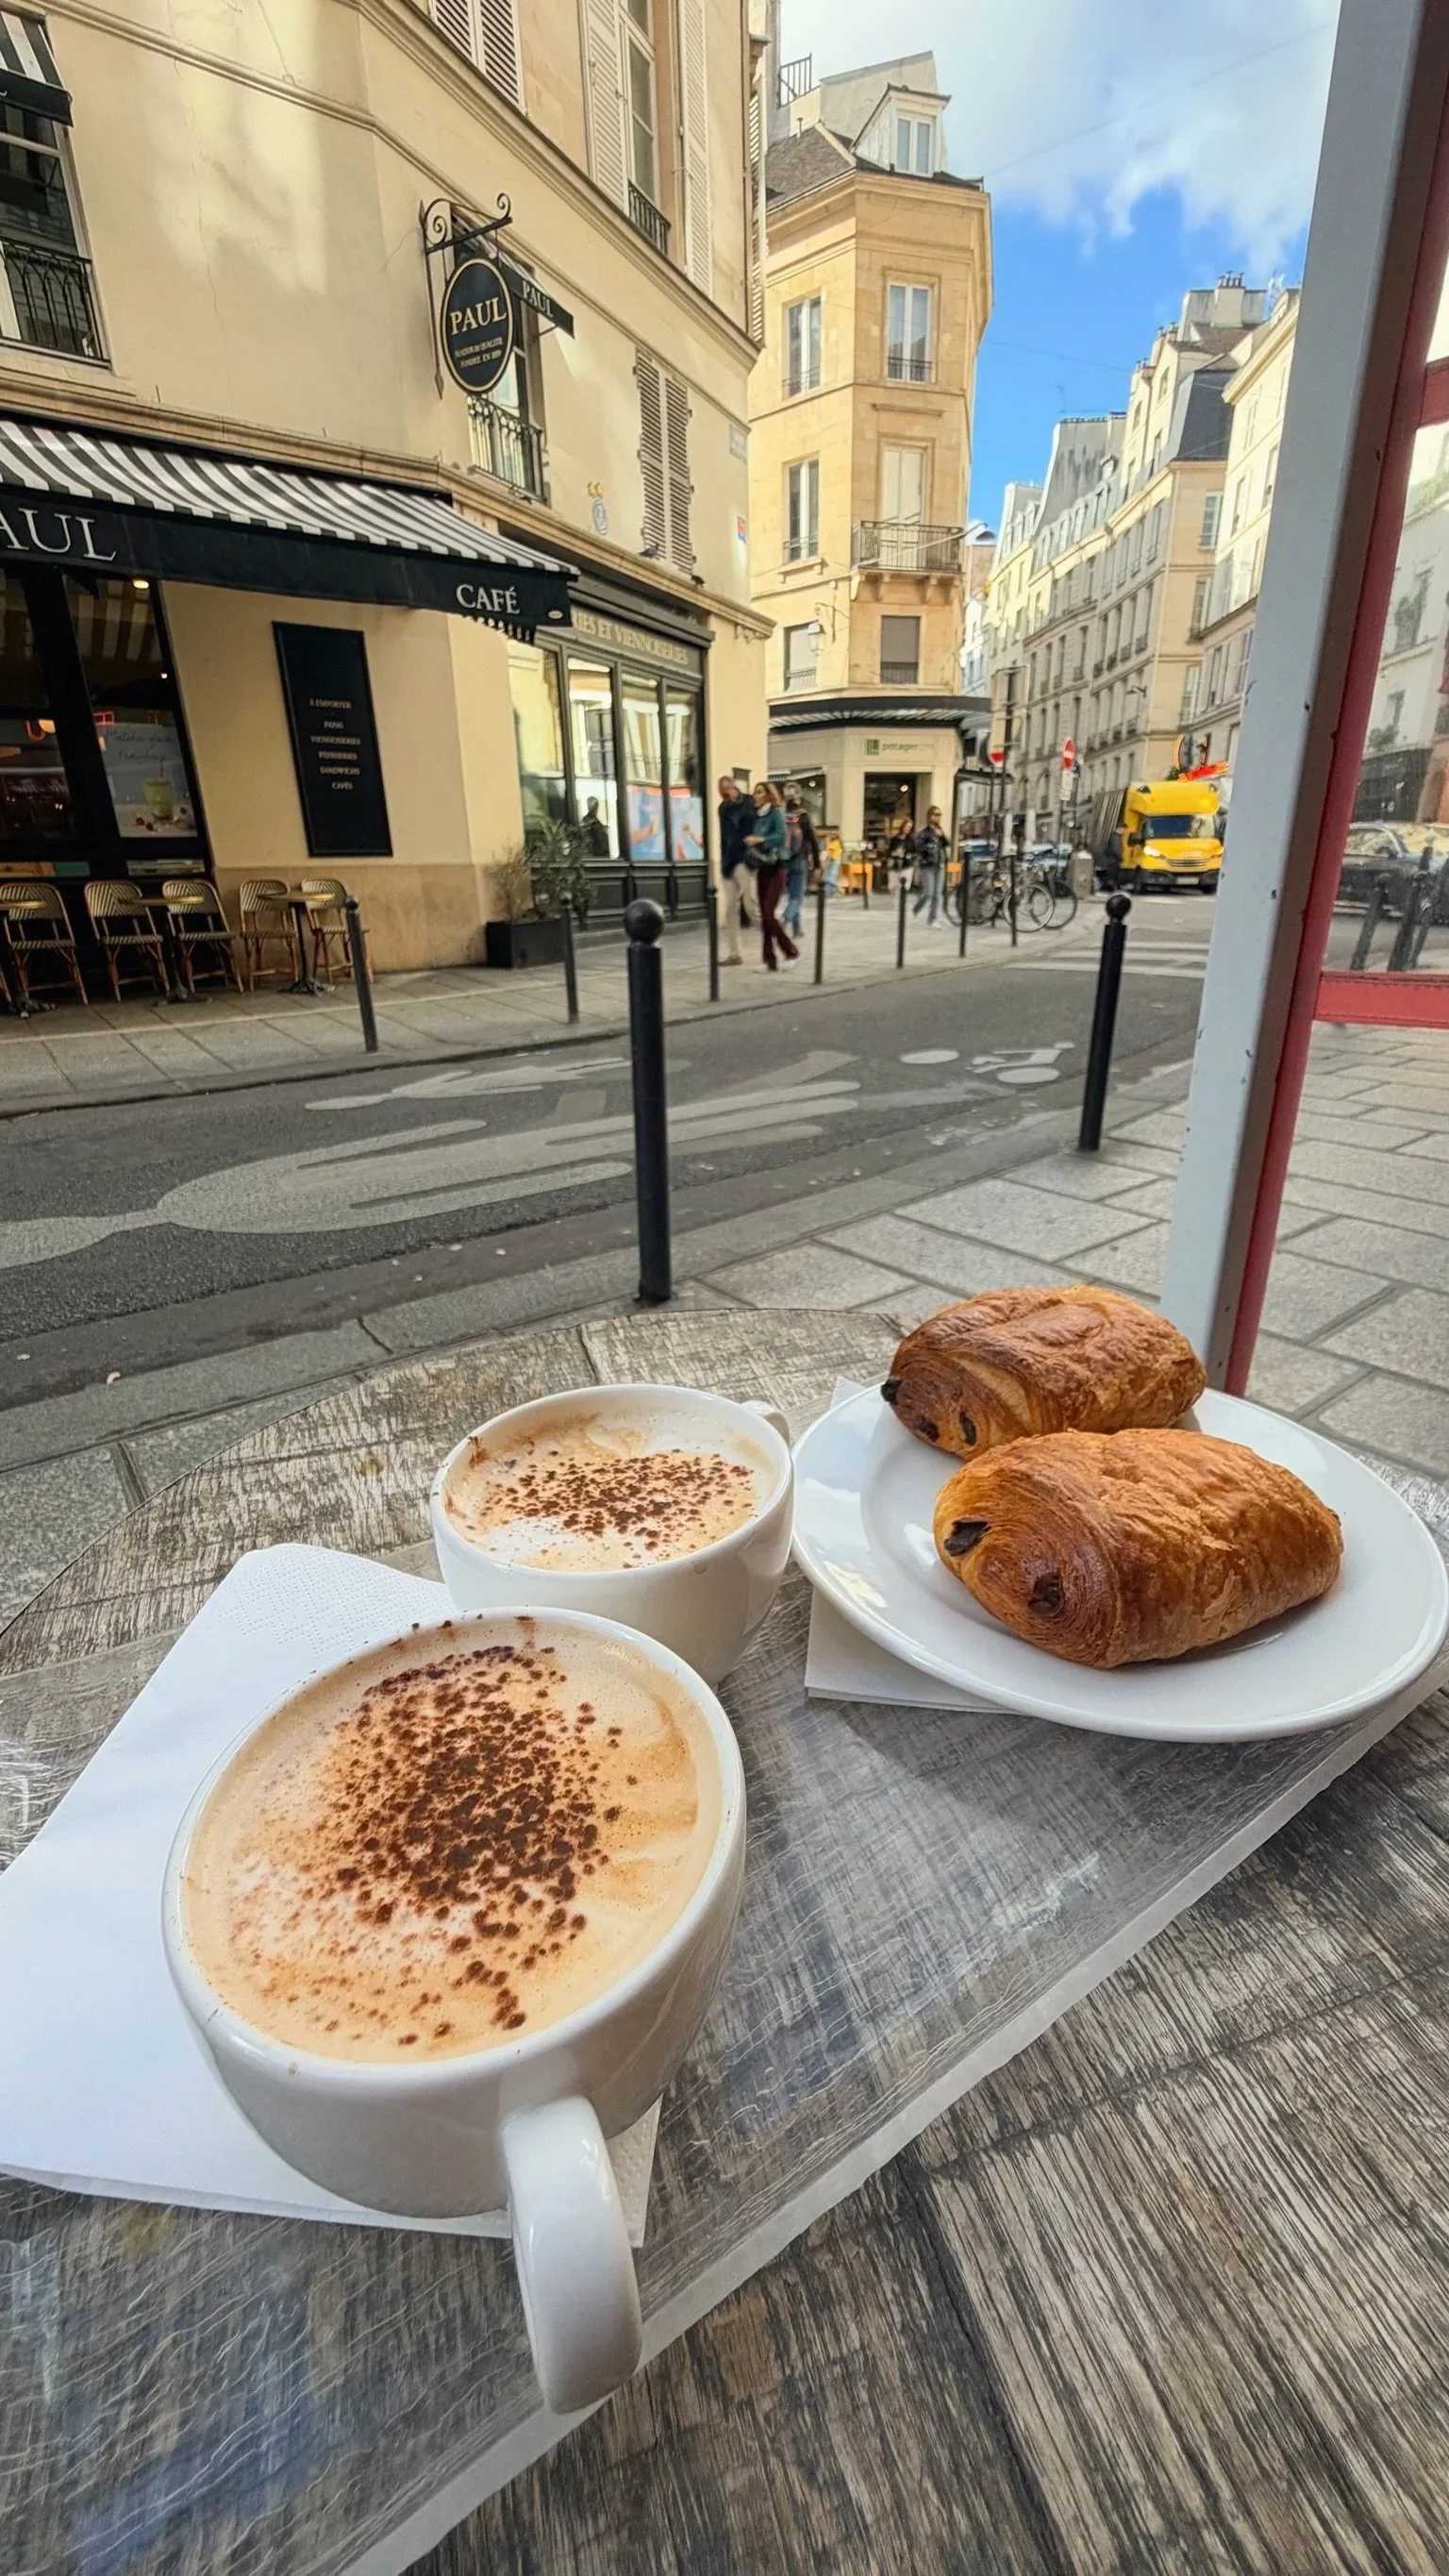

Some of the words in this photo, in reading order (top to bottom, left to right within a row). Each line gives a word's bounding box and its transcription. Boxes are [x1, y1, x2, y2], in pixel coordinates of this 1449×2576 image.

[449, 296, 507, 336] PAUL
[522, 280, 554, 318] PAUL
[456, 584, 520, 614] CAFÉ
[597, 618, 612, 641] ET
